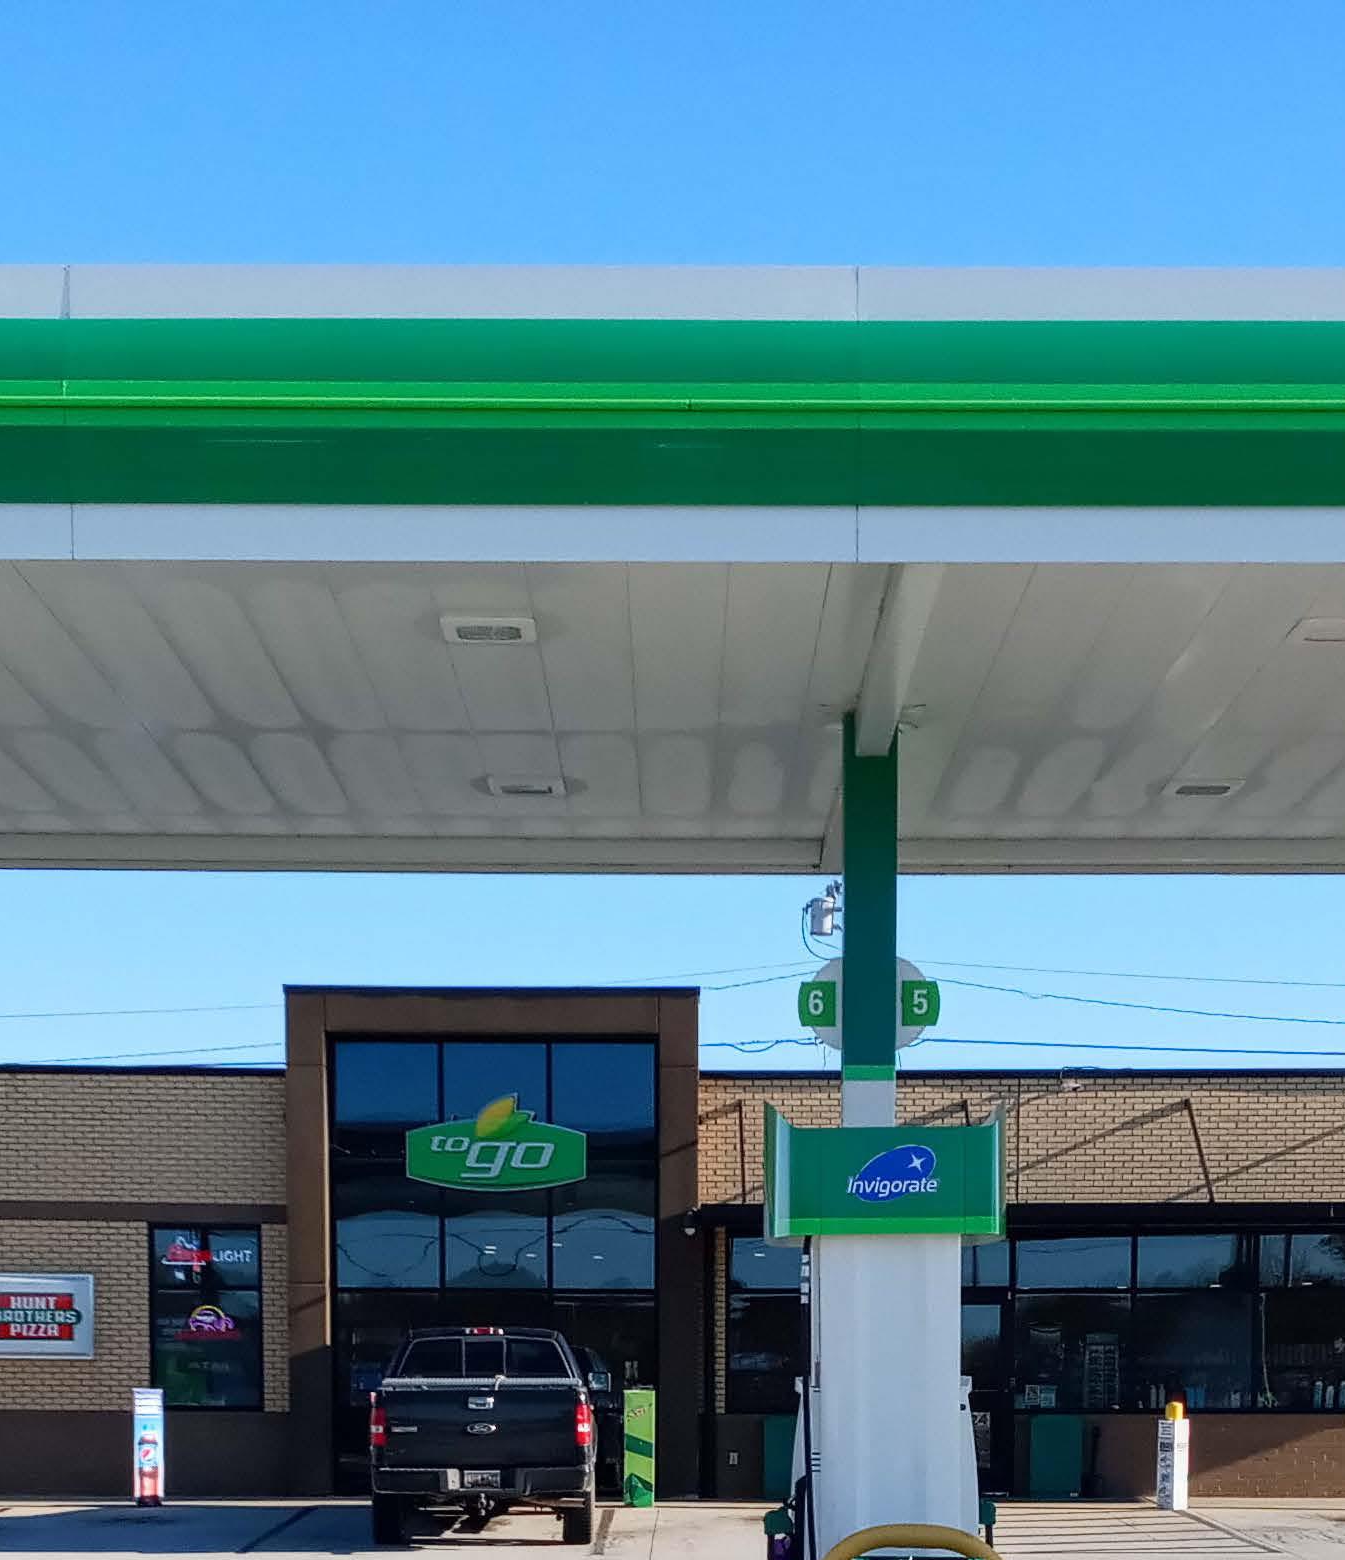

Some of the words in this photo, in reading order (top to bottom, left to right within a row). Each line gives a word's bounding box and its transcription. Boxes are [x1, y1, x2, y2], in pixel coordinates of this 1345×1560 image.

[808, 989, 824, 1015] 6
[913, 988, 928, 1015] 5
[846, 1176, 938, 1198] Invigorate
[9, 1295, 58, 1310] HUNT
[9, 1323, 60, 1337] PIZZA
